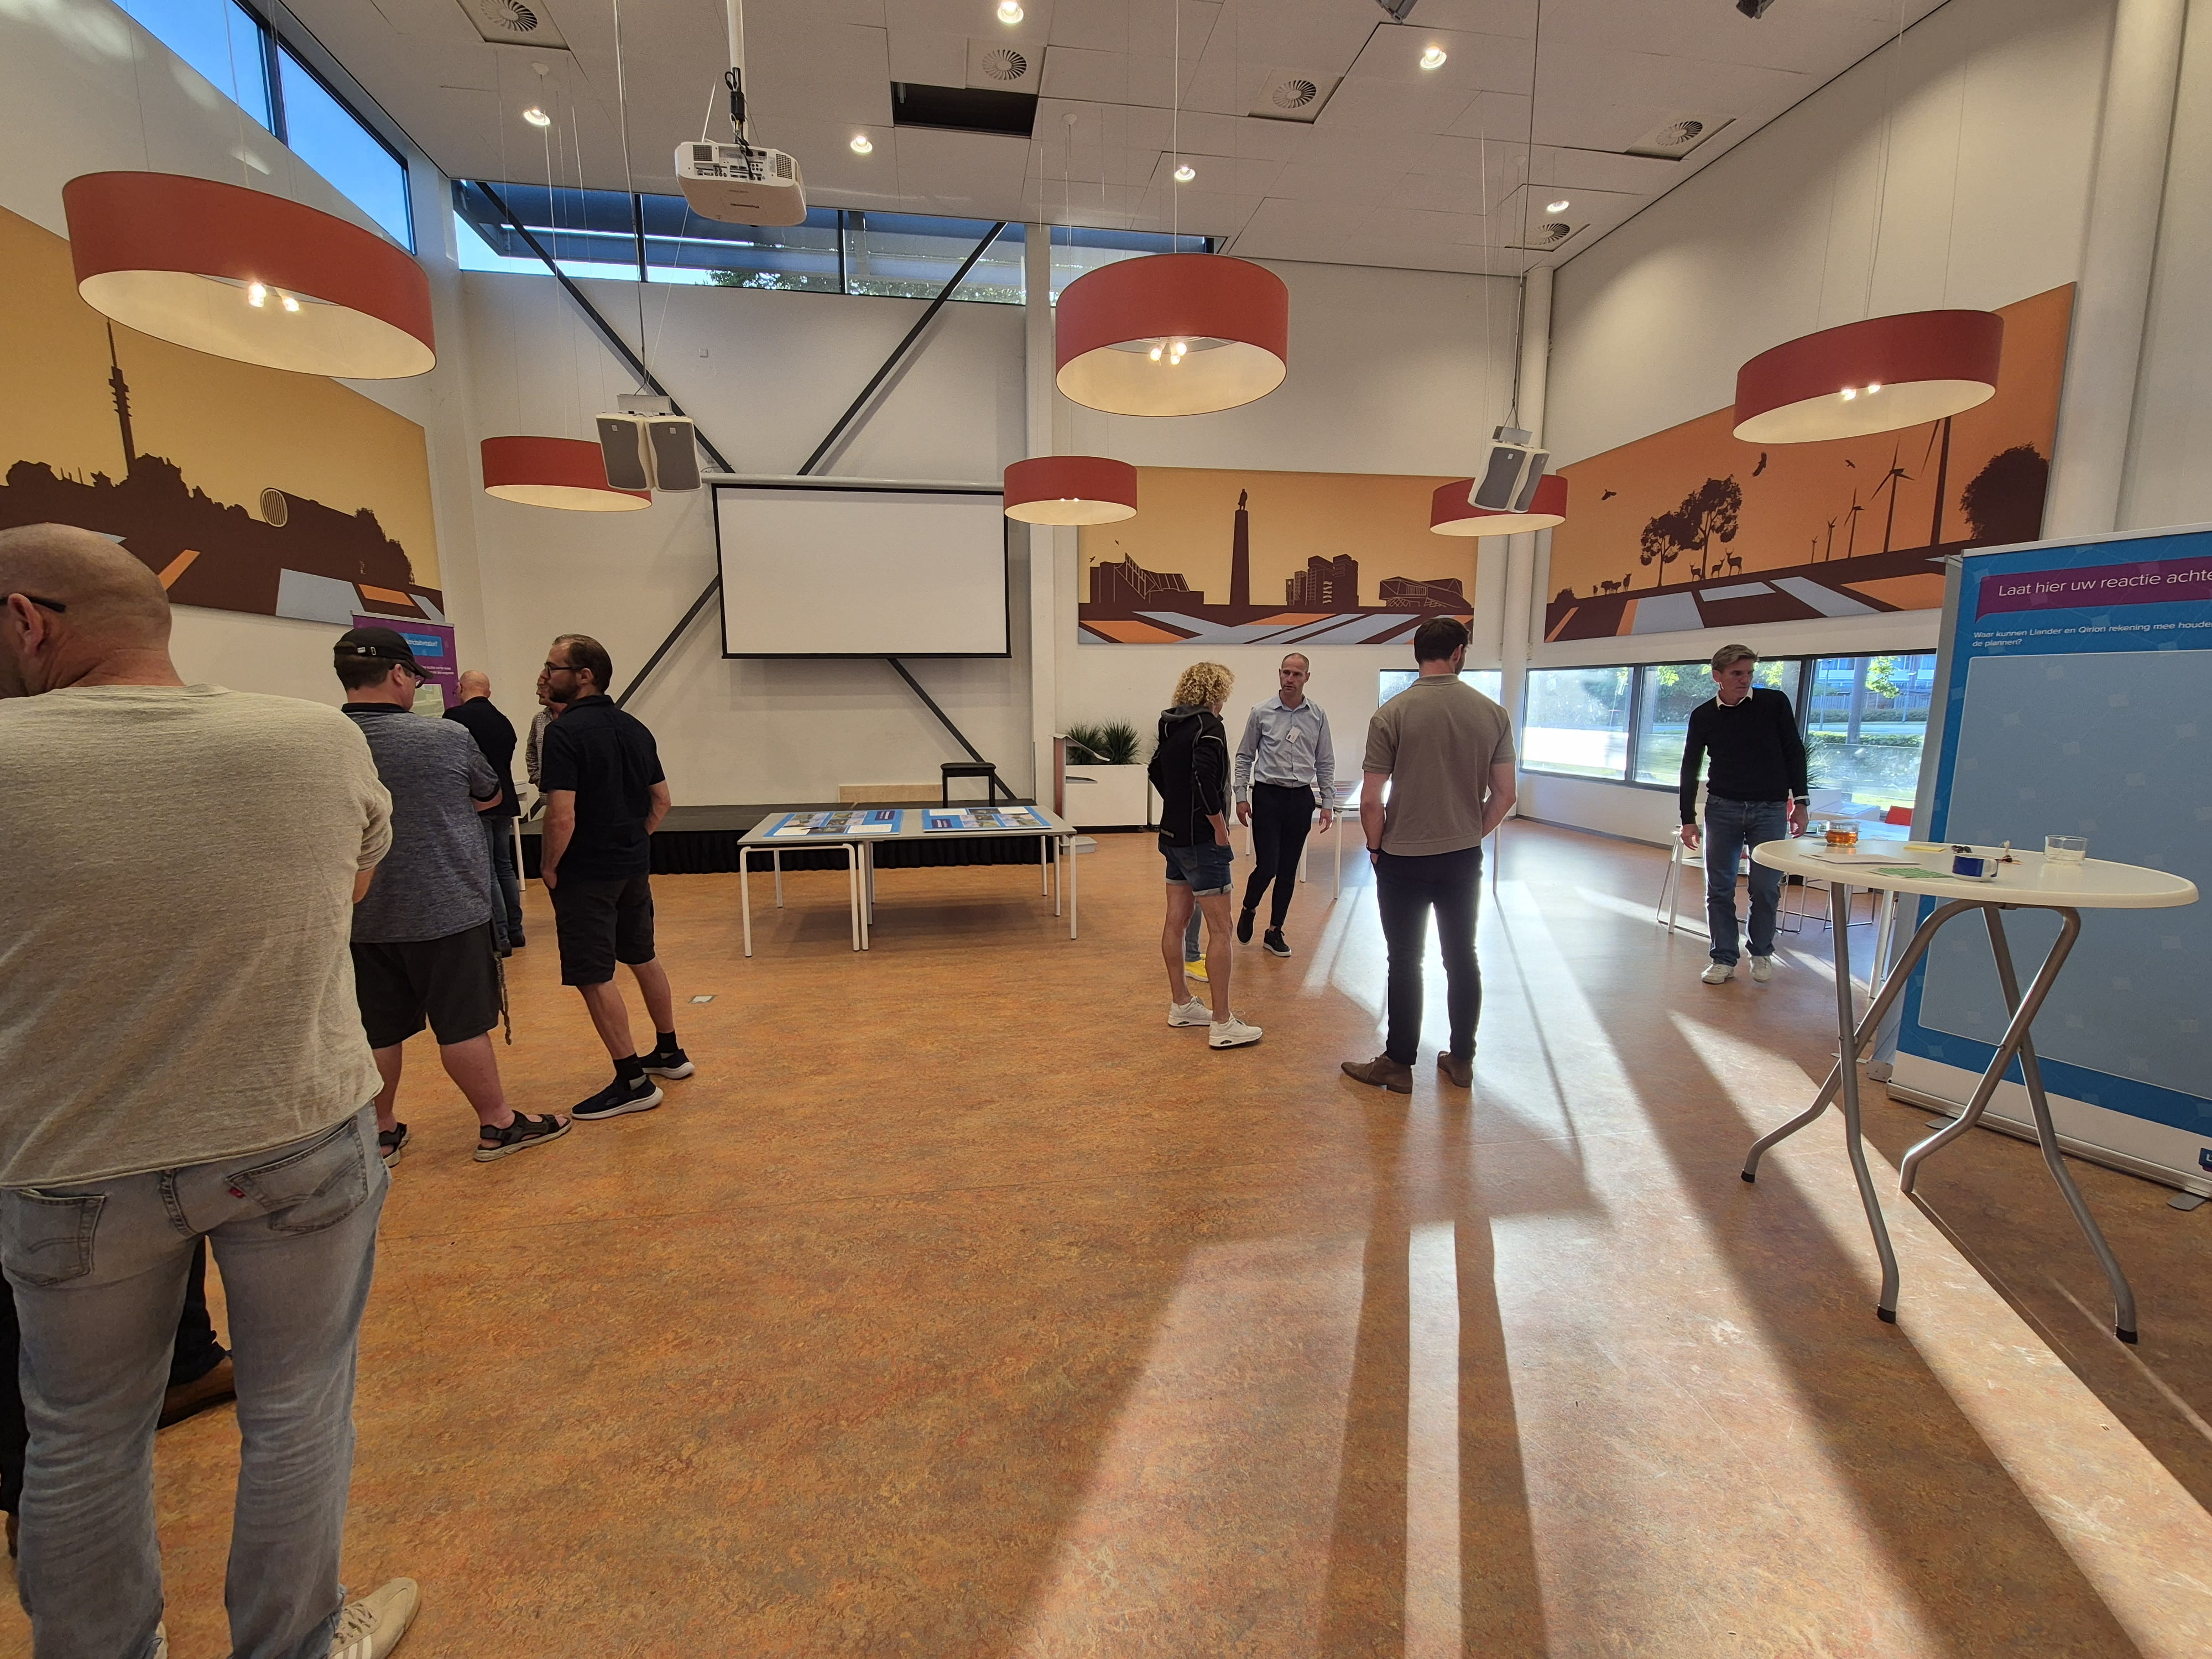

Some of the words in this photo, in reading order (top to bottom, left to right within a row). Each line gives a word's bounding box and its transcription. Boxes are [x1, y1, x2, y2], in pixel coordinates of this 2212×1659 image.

[1999, 585, 2031, 596] Laat
[2035, 582, 2067, 593] hier
[2071, 580, 2096, 591] uw
[2101, 574, 2161, 588] reactie
[2109, 624, 2151, 632] rekening
[2178, 620, 2212, 629] houde
[1985, 638, 2022, 647] plannen?
